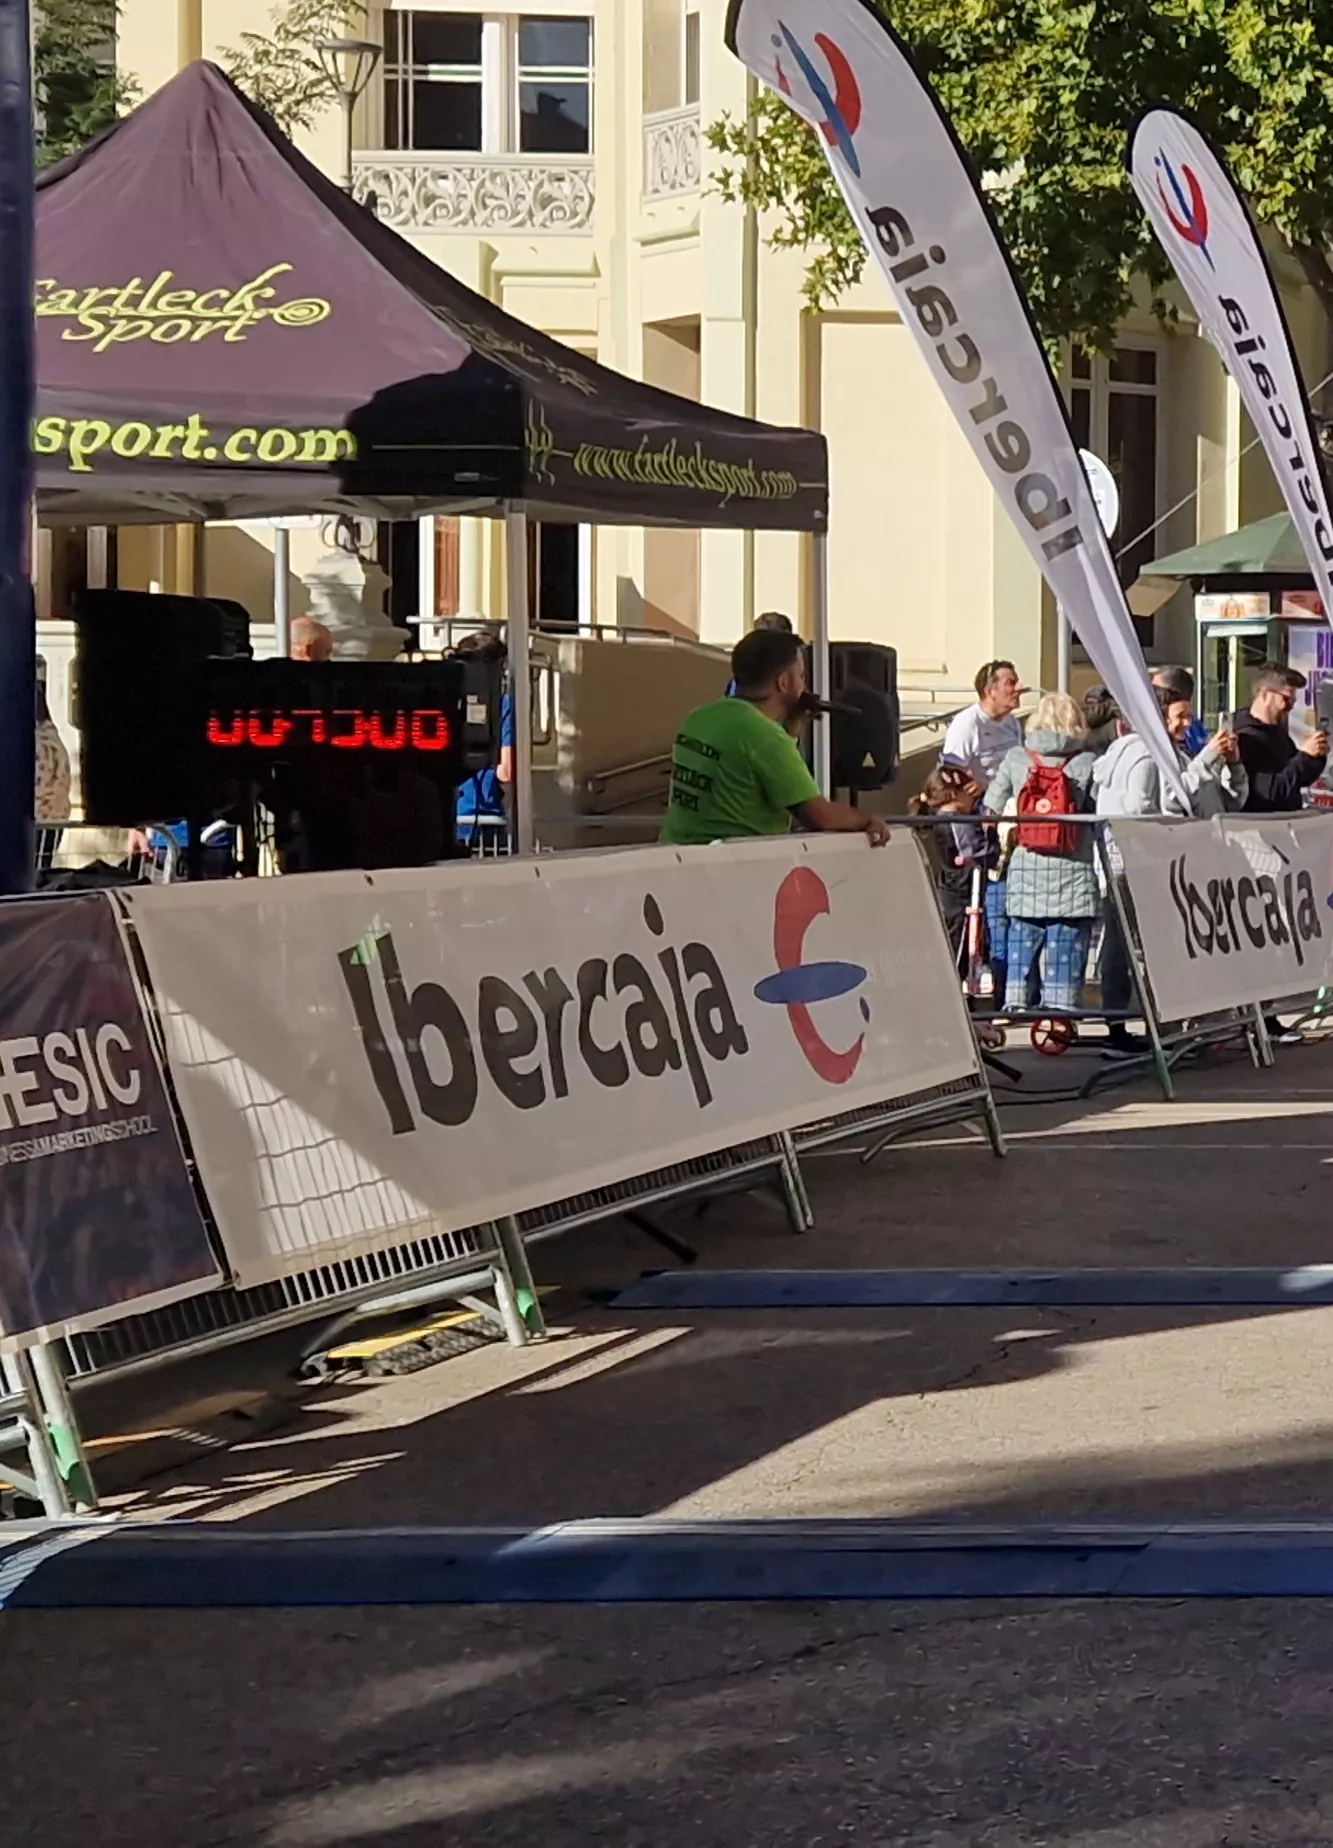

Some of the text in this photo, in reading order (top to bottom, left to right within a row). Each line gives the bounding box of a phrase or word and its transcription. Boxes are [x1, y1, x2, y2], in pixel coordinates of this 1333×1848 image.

[61, 306, 256, 353] Sport
[574, 432, 797, 508] www.fartlecksport.com
[1169, 844, 1322, 966] Ibercaja
[336, 892, 749, 1135] Ibercaja
